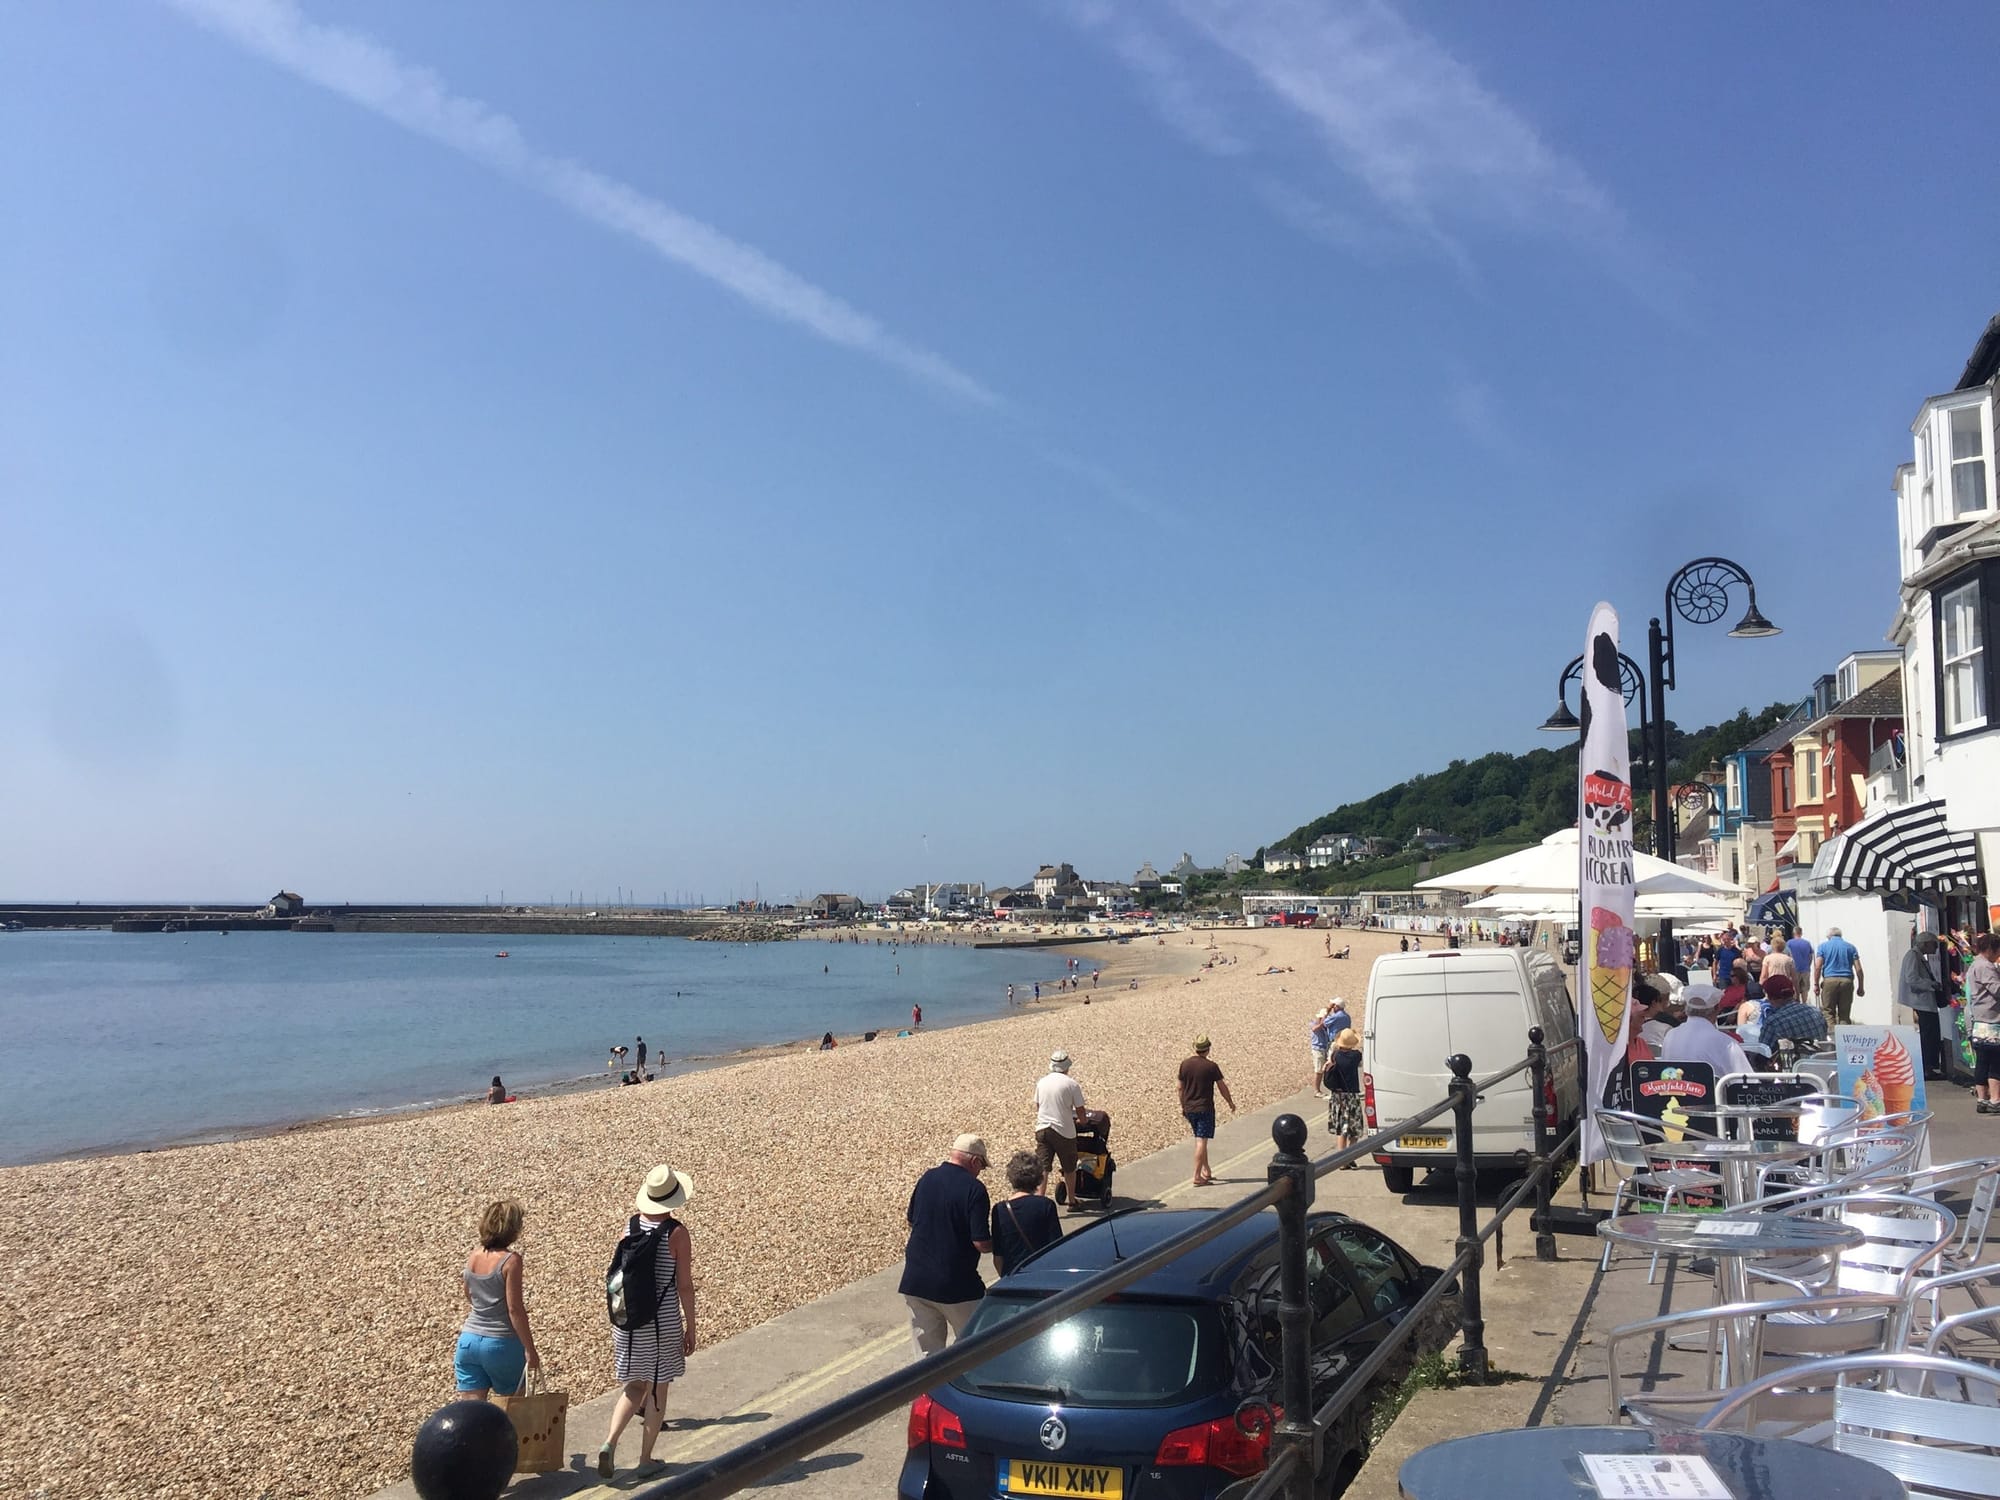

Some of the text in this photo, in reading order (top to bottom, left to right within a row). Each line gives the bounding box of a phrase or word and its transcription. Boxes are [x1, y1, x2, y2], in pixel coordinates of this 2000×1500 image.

[1842, 1033, 1878, 1047] Whippy
[1850, 1054, 1865, 1064] £2
[945, 1453, 970, 1463] ASTRA
[1022, 1463, 1110, 1494] VK11 XMY
